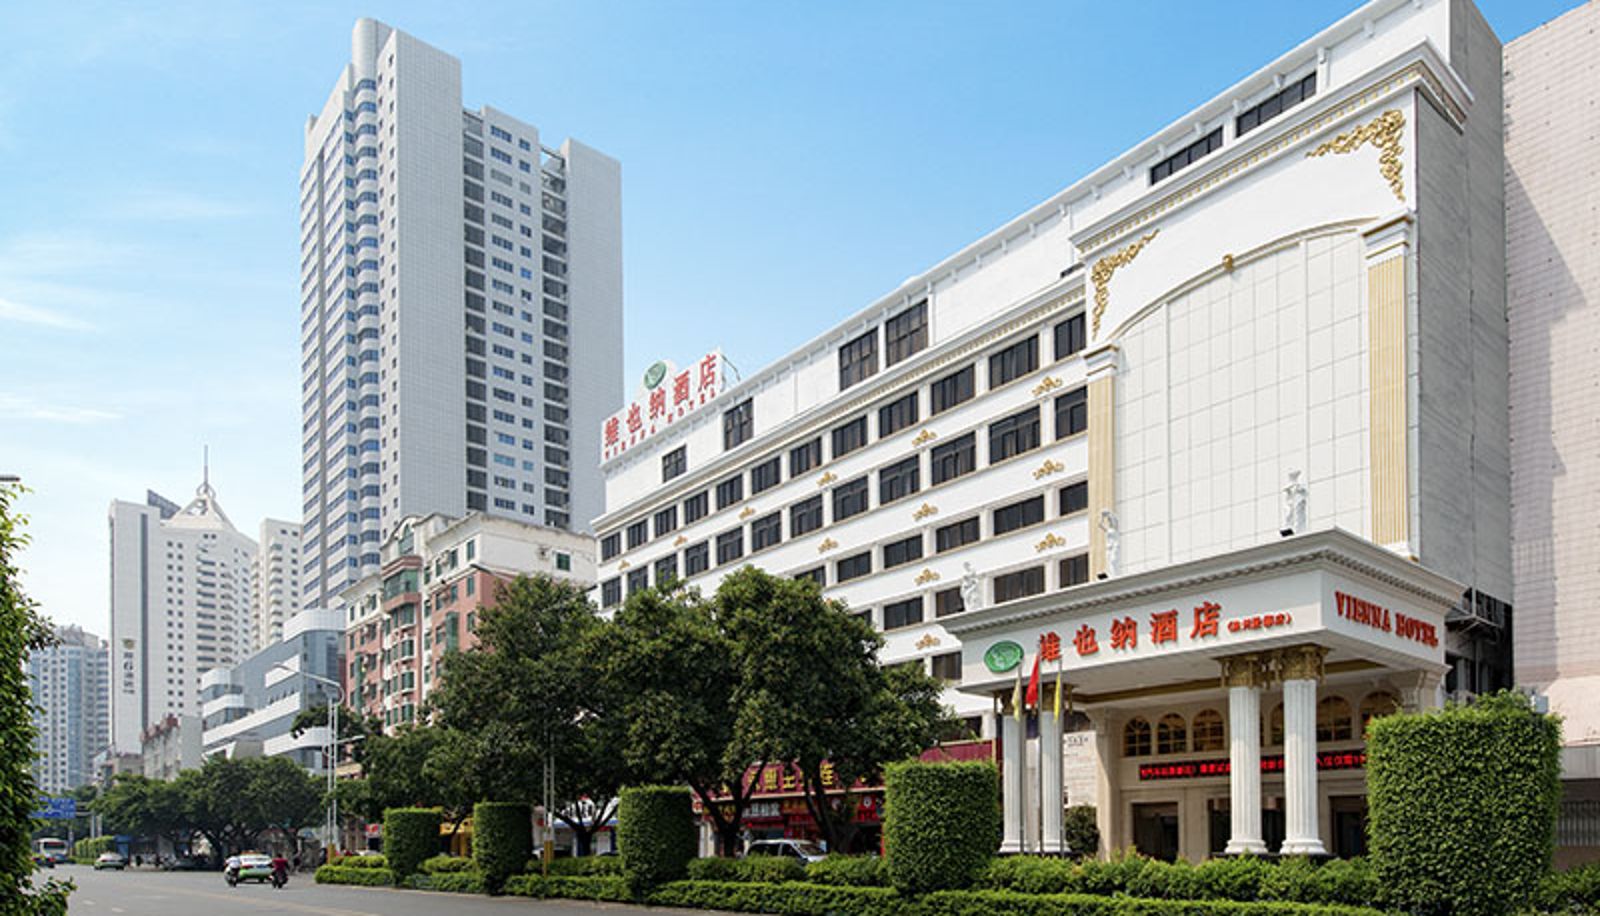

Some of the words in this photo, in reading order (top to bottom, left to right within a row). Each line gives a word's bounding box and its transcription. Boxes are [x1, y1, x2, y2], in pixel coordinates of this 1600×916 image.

[604, 354, 716, 448] 维也纳酒店
[1039, 600, 1221, 662] 维也纳酒店
[1335, 590, 1392, 633] VIENNA
[1395, 612, 1439, 648] HOTEL
